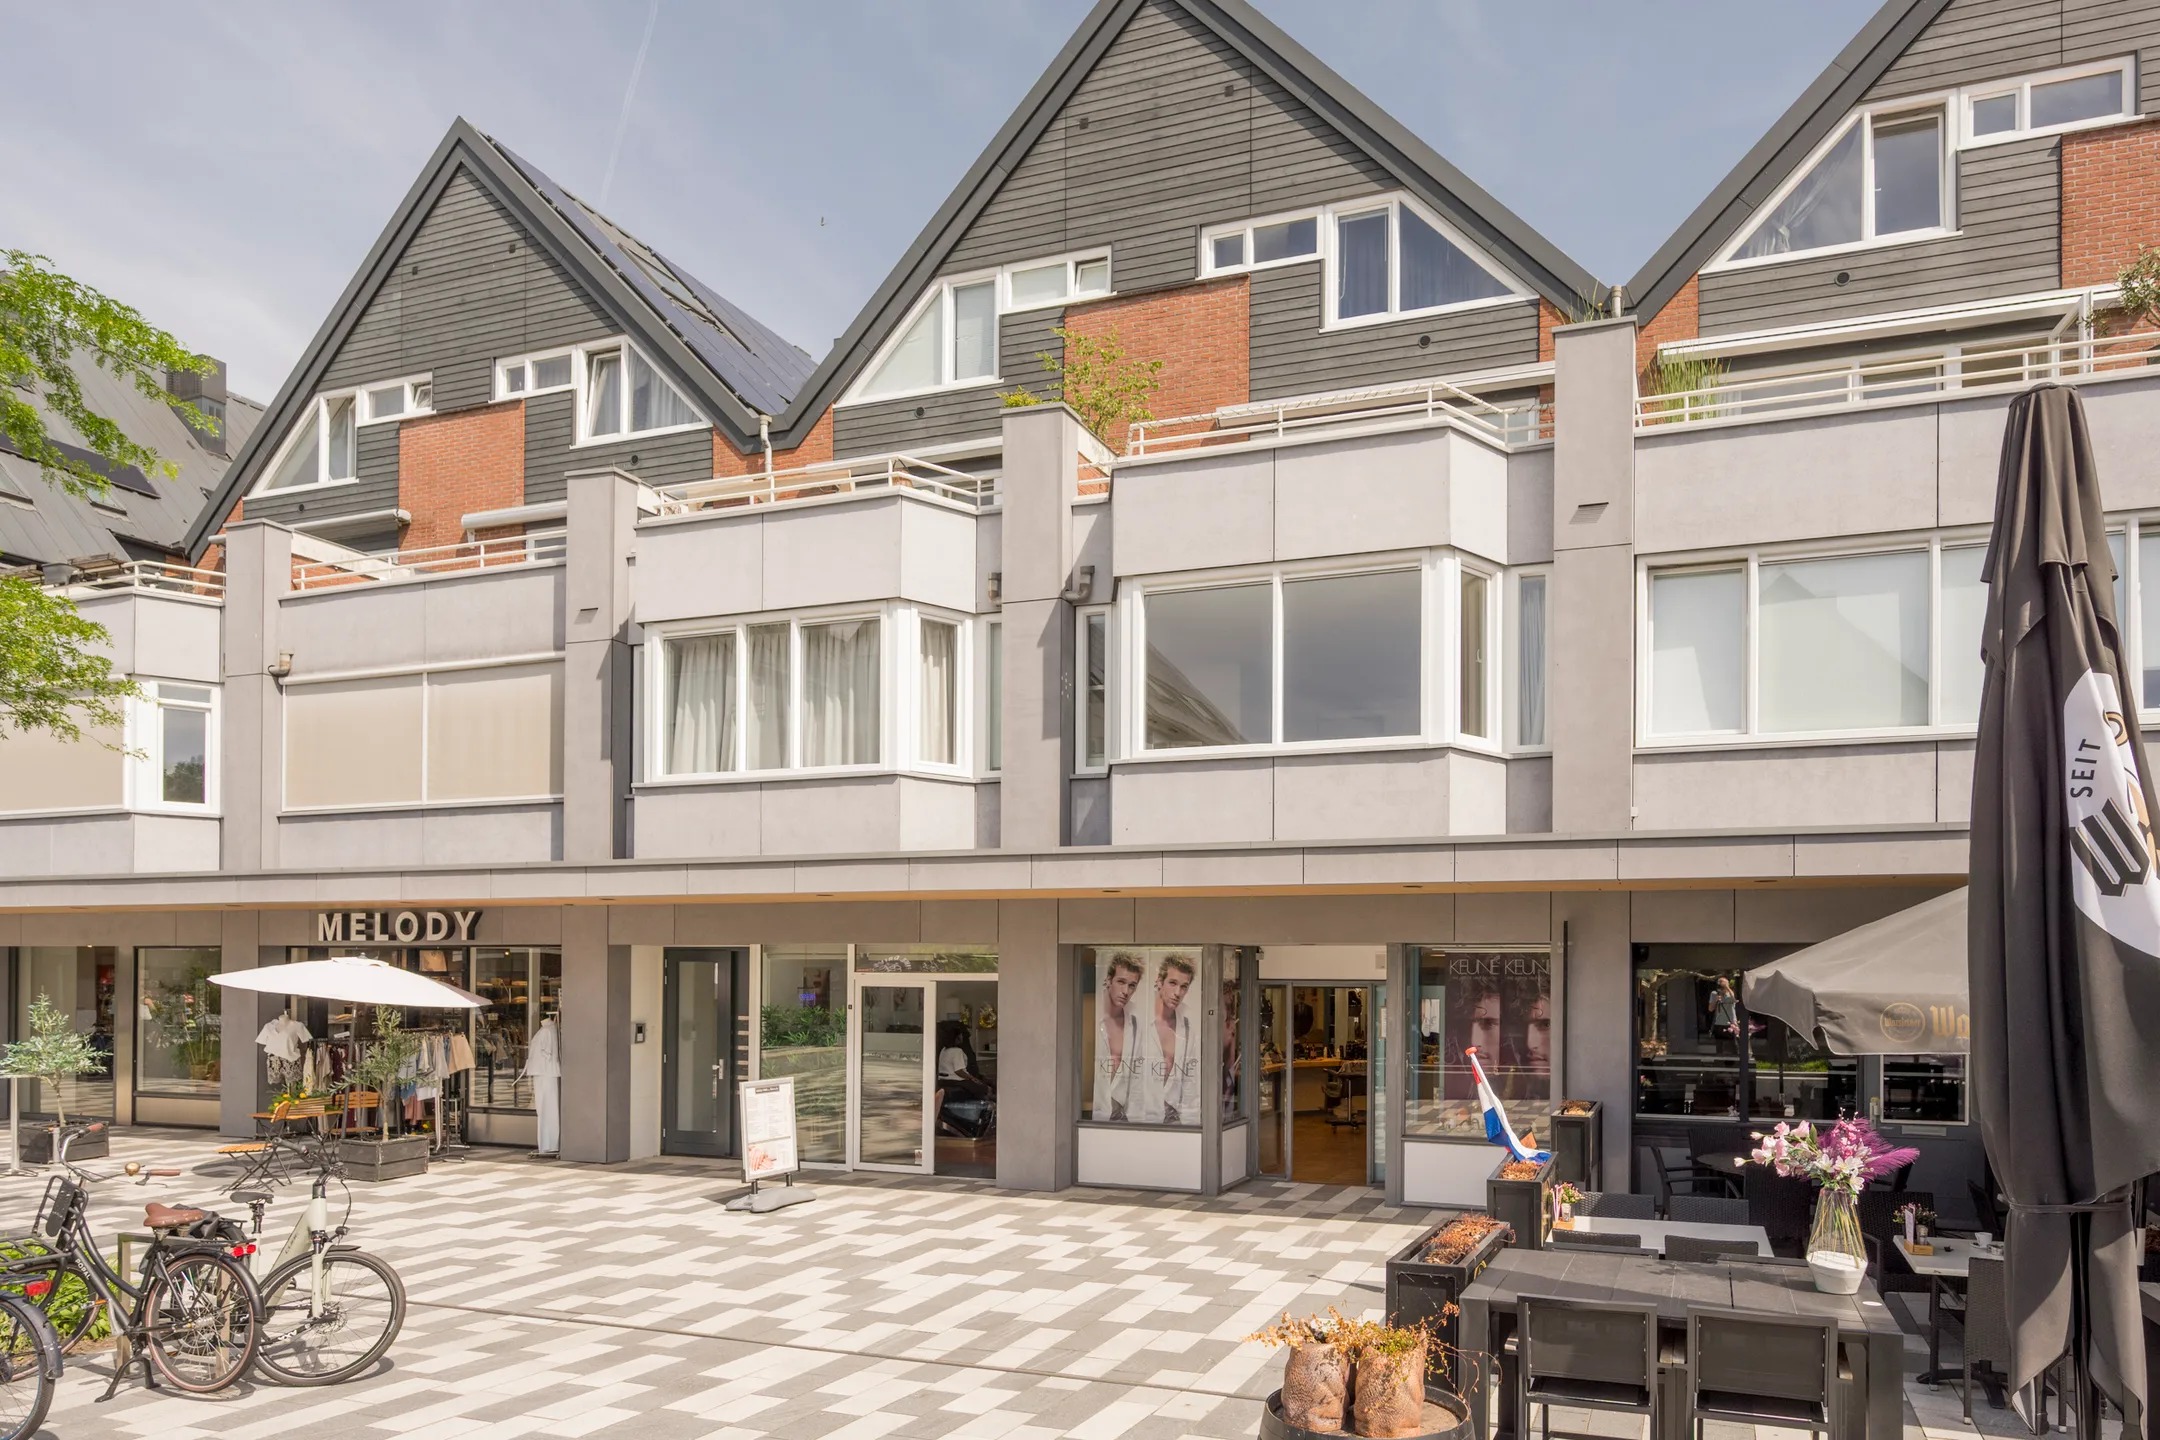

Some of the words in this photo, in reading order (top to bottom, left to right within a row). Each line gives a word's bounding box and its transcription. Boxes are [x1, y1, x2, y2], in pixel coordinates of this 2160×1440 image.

[2069, 738, 2101, 798] SEIT
[318, 911, 476, 943] MELODY
[1449, 958, 1500, 975] KEUNE
[1100, 1058, 1142, 1075] KEUNE
[1152, 1060, 1195, 1078] KEUNE
